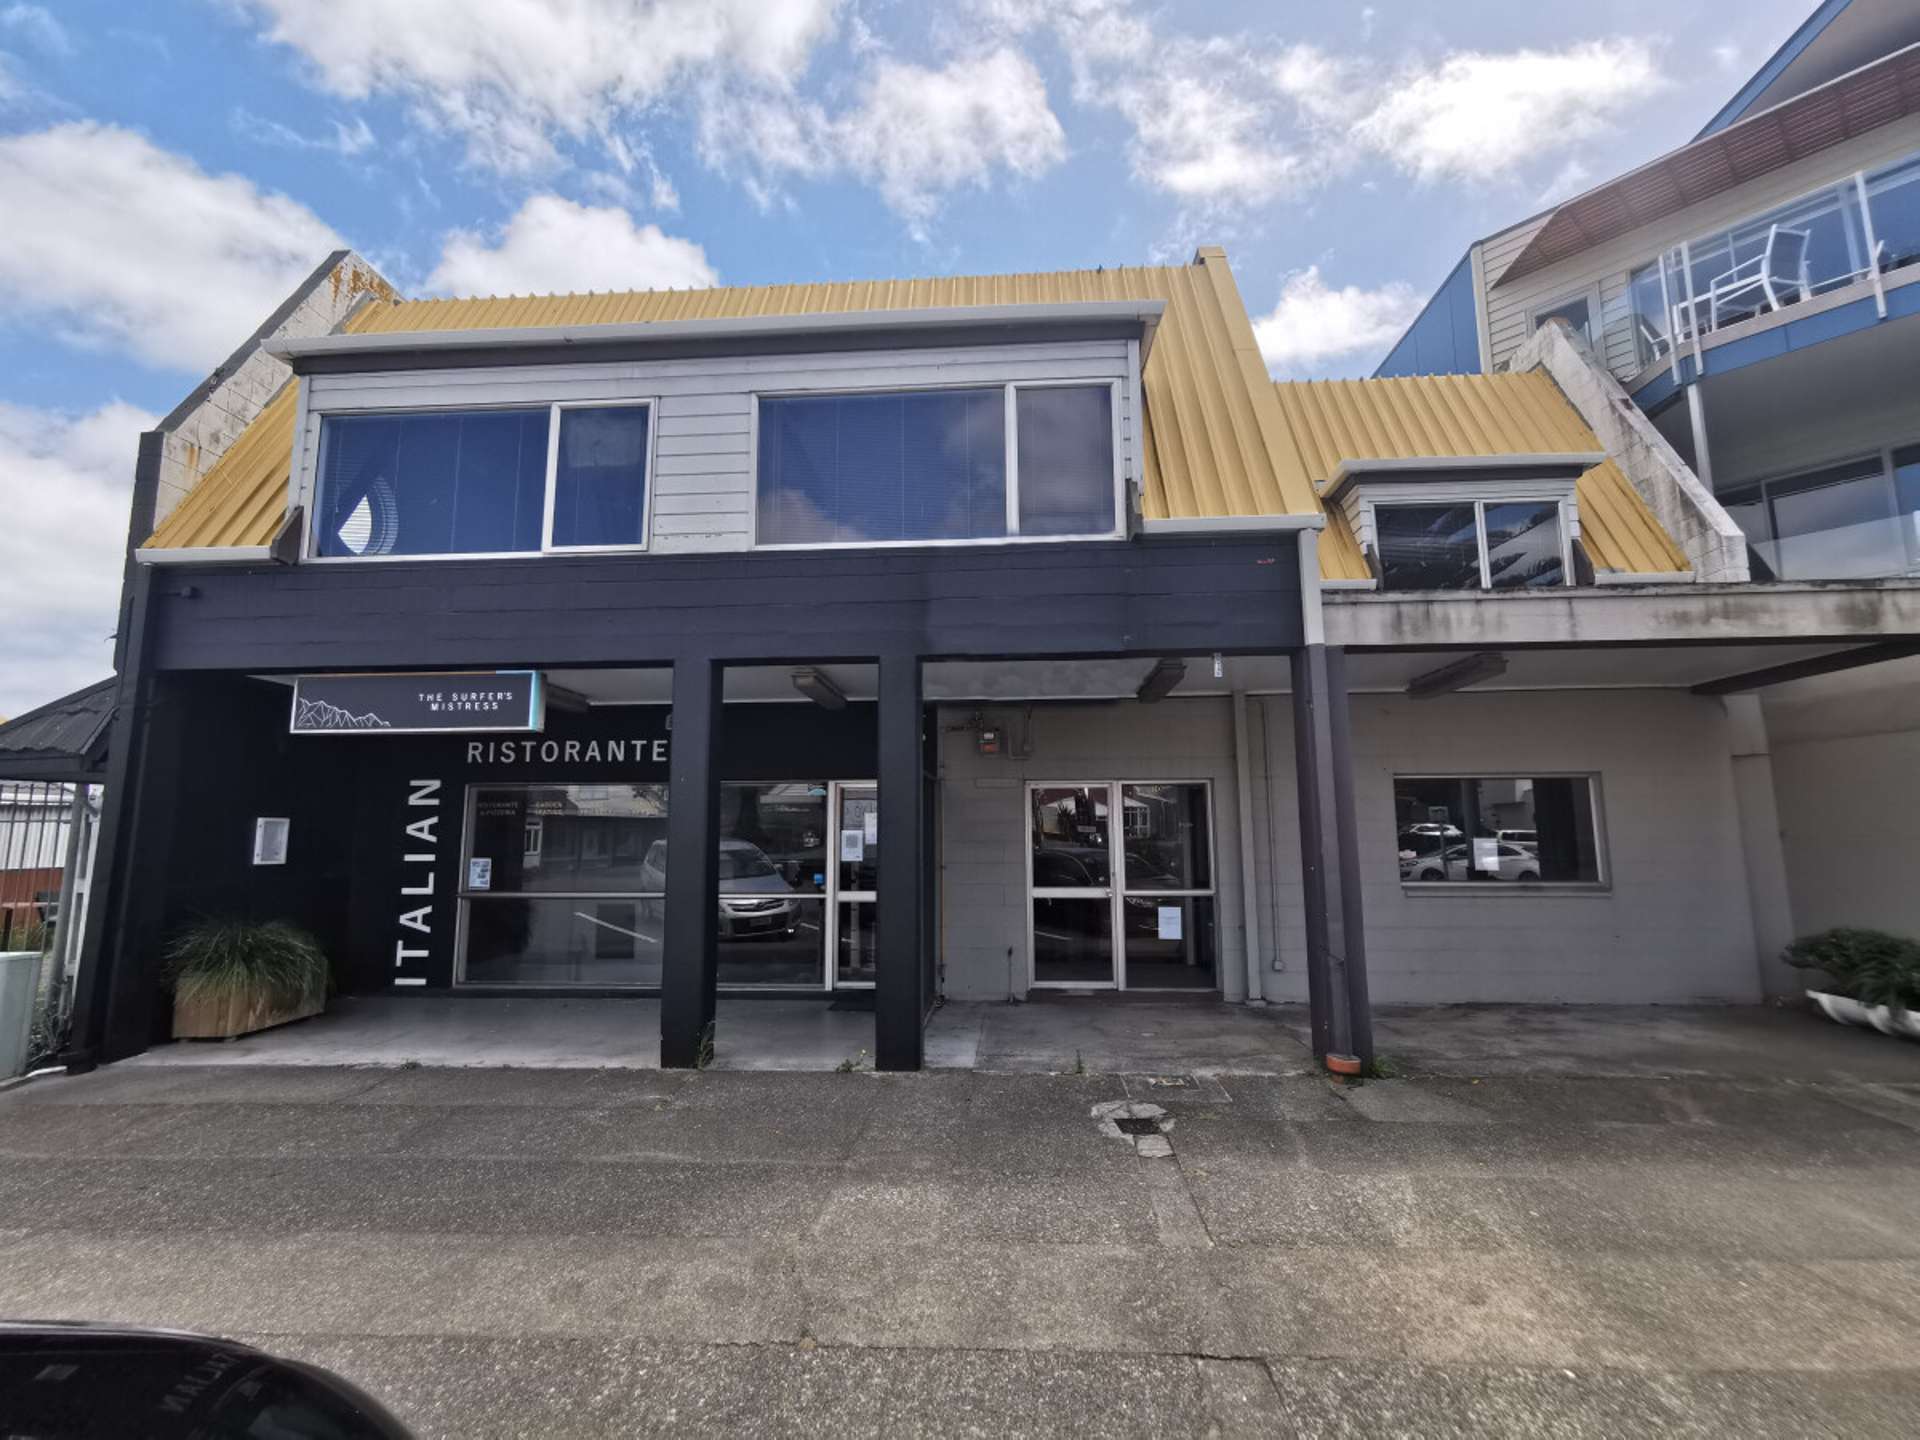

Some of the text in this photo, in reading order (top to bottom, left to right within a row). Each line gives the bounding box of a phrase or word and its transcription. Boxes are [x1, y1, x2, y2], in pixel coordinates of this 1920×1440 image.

[418, 692, 443, 702] THE
[430, 701, 499, 712] MISTRESS
[466, 739, 669, 764] RISTORANTE
[394, 779, 442, 986] ITALIAN
